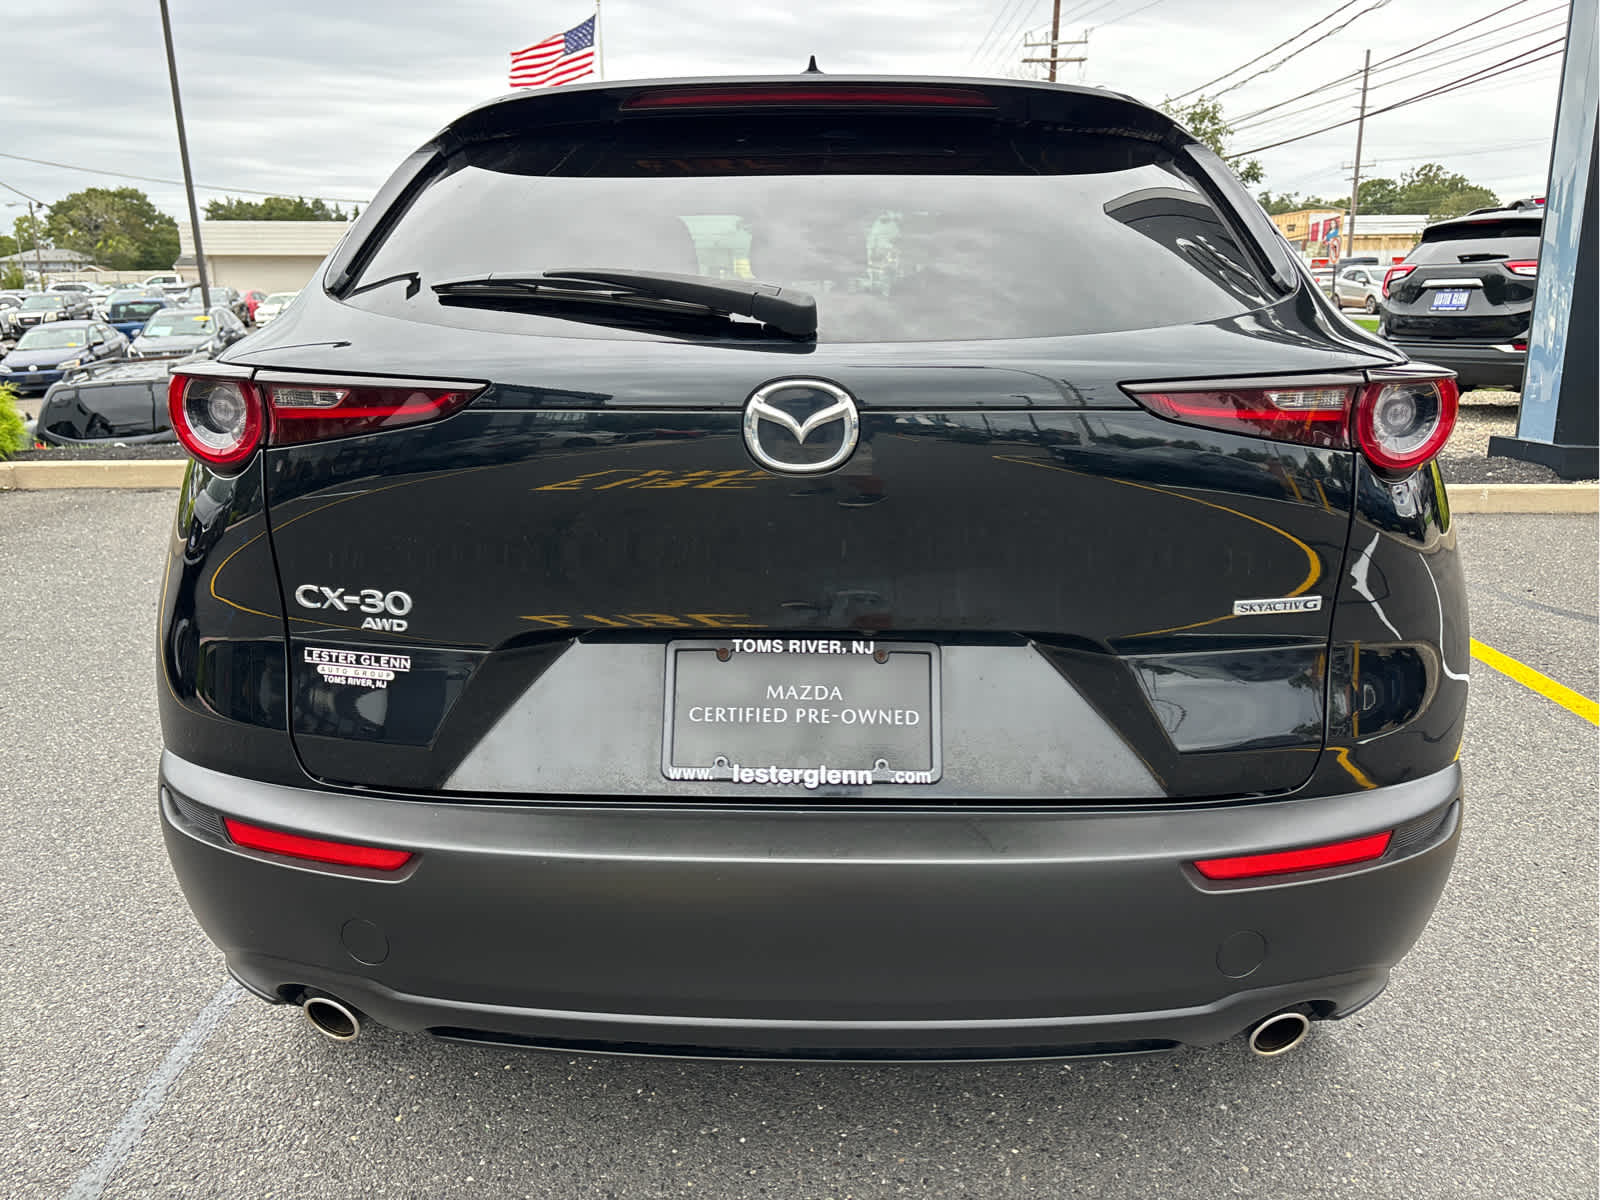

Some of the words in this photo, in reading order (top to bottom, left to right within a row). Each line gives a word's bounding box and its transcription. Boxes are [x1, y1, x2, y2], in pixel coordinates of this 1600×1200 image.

[295, 584, 412, 616] CX-30
[361, 617, 408, 632] AWD
[732, 639, 784, 653] TOMS
[788, 640, 847, 655] RIVER,
[852, 641, 875, 655] NJ
[304, 650, 356, 664] LESTER
[360, 656, 411, 669] GLENN
[320, 666, 348, 675] AUTO
[354, 669, 391, 679] GROUP
[323, 675, 346, 685] TOMS
[347, 677, 375, 689] RIVER,
[375, 680, 387, 689] NJ
[766, 685, 843, 700] MAZDA
[689, 707, 788, 723] CERTIFIED
[796, 708, 920, 725] PRE-OWNED
[668, 768, 713, 780] www.
[733, 764, 873, 788] lesterglenn
[890, 770, 932, 784] .com
